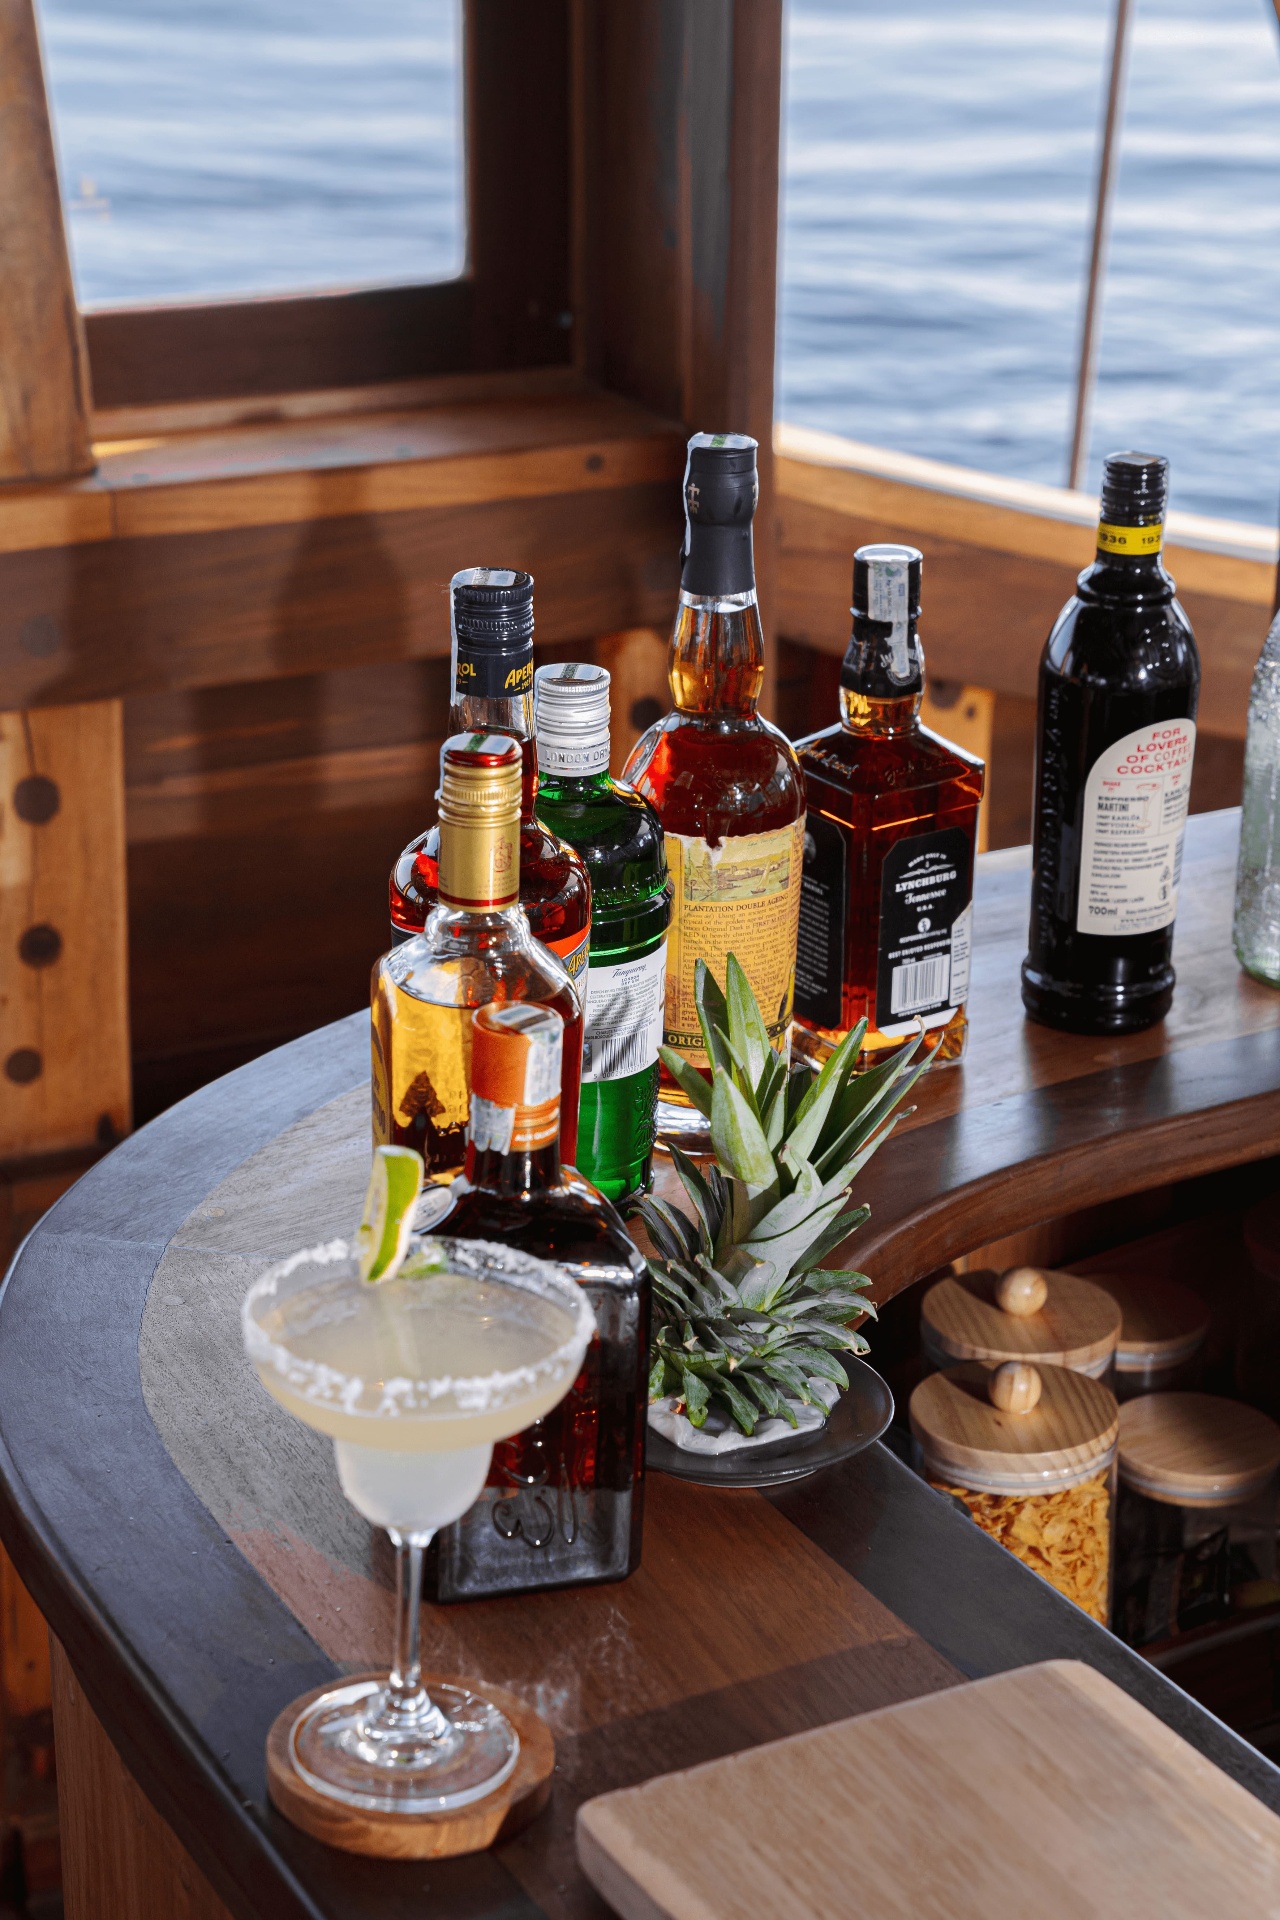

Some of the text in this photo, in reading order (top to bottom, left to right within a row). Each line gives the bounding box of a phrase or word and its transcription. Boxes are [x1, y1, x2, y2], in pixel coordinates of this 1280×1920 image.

[1099, 532, 1127, 545] 936
[1142, 533, 1161, 545] 193
[456, 663, 477, 677] ROL
[504, 657, 534, 689] APER
[1152, 728, 1181, 740] FOR
[1137, 735, 1188, 753] LOVERS
[544, 750, 590, 763] LONDON
[1126, 755, 1149, 764] OF
[1097, 802, 1129, 812] MARTINI
[895, 870, 957, 893] LYNCHBURG
[684, 893, 789, 912] PLANTATION DOUBLE AGEING
[904, 888, 947, 905] Tennessee
[916, 904, 935, 913] U.S.A.
[1088, 905, 1118, 916] 700ml
[725, 918, 746, 926] golden
[753, 920, 769, 928] FIRST
[723, 938, 746, 946] tropical
[732, 949, 757, 957] lavours
[612, 963, 648, 979] Tanqueray
[668, 1035, 705, 1047] ORIG
